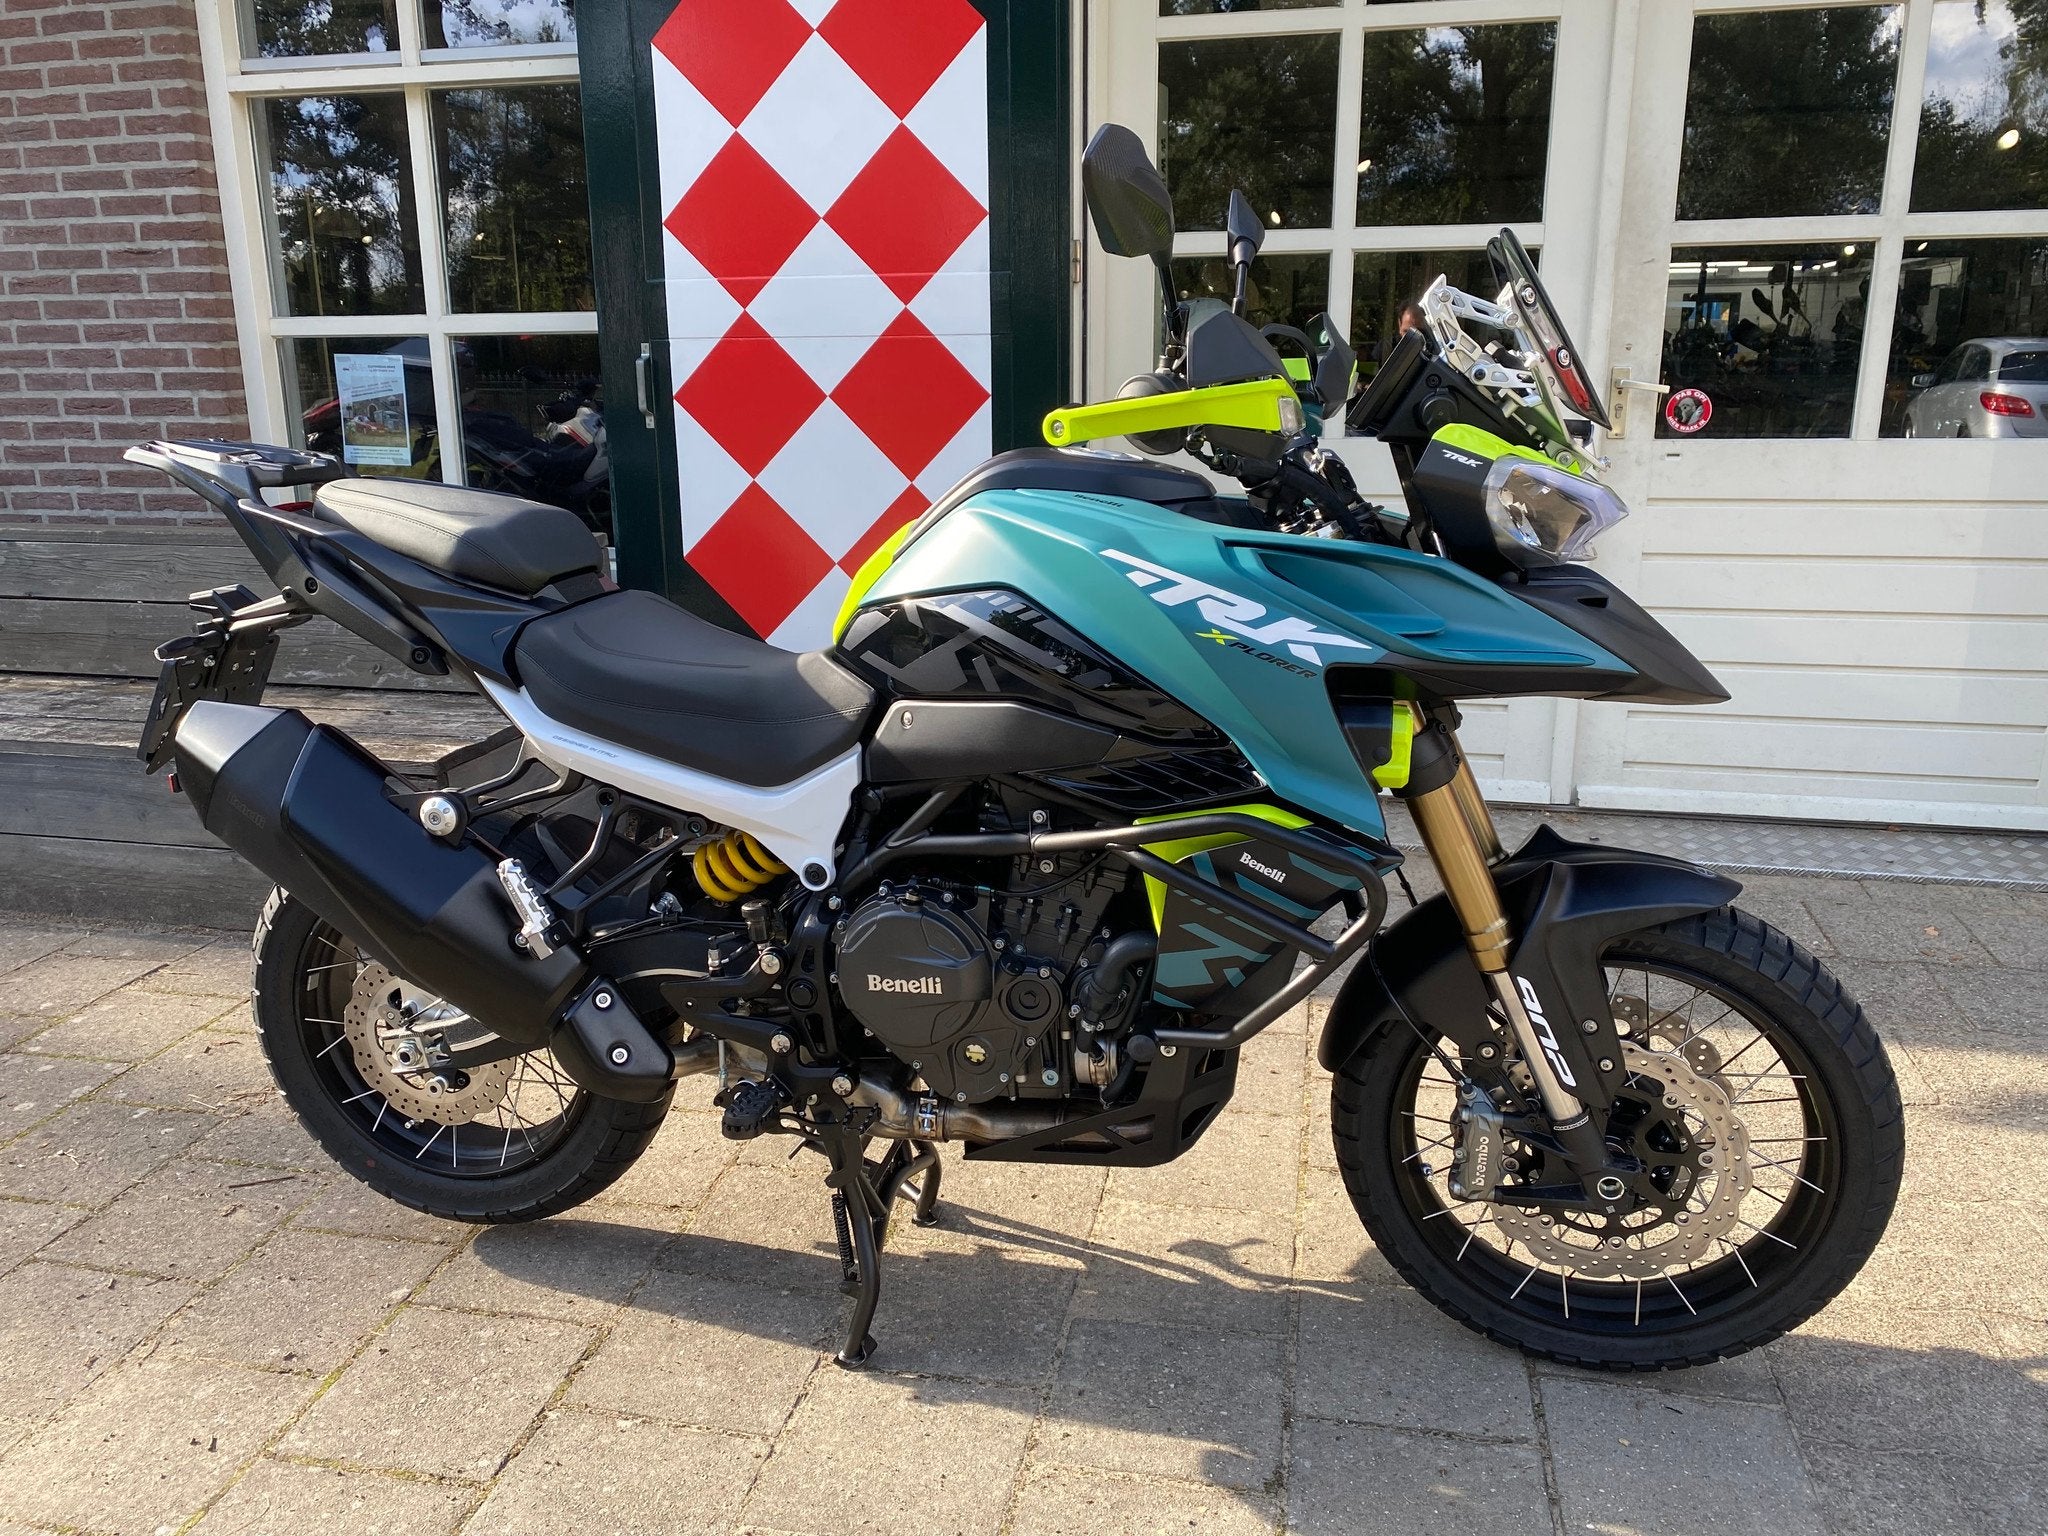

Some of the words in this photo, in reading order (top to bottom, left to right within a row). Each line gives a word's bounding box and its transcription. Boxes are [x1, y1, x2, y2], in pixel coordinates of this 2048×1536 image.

[1675, 390, 1692, 400] PAS
[1668, 416, 1680, 429] HIER
[1680, 423, 1699, 431] WAAK
[1442, 449, 1484, 468] TRK
[1074, 494, 1124, 507] Benelli
[1098, 548, 1373, 668] TRK
[1240, 851, 1287, 884] Benelli
[866, 974, 943, 995] Benelli
[1471, 1136, 1490, 1187] brembo
